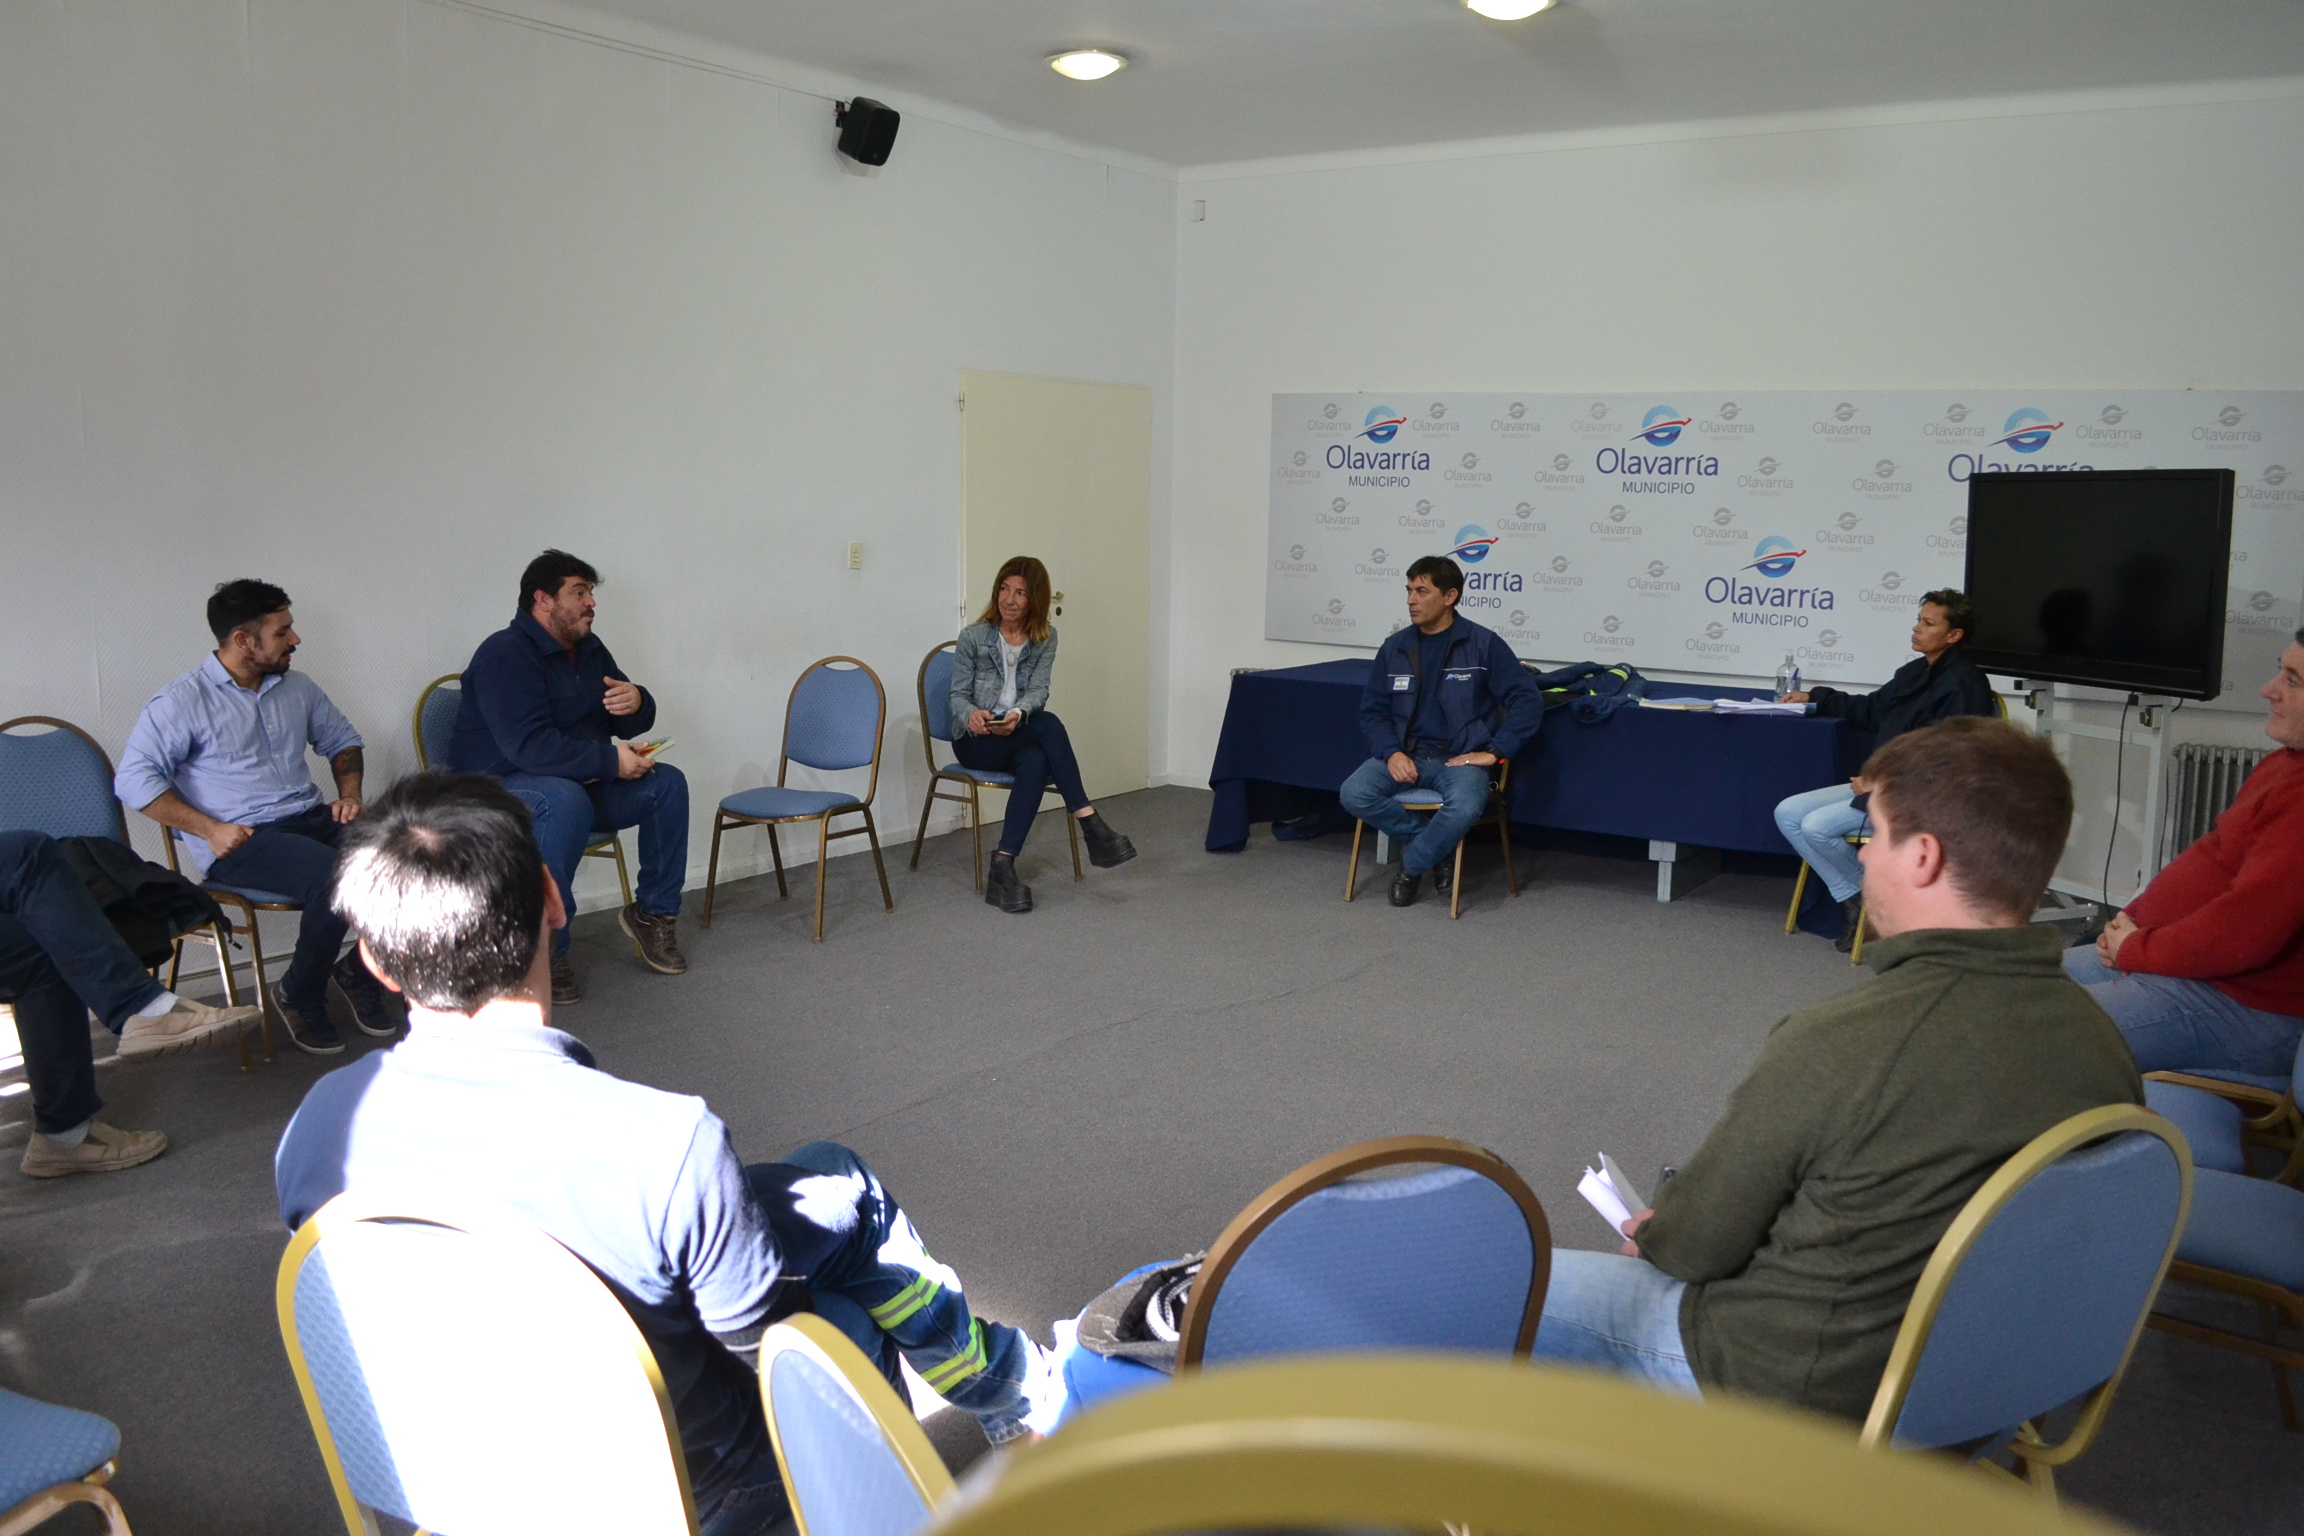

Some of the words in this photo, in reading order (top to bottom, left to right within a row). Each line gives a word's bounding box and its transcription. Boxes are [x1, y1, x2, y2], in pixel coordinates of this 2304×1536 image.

[1326, 444, 1430, 470] Olavarría
[1596, 447, 1719, 477] Olavarría
[1348, 476, 1410, 487] MUNICIPIO
[1622, 481, 1695, 494] MUNICIPIO
[1925, 535, 1964, 548] Olava
[1463, 571, 1523, 593] arría
[1704, 576, 1834, 610] Olavarría
[1460, 596, 1502, 609] NICIPIO
[1732, 612, 1809, 628] MUNICIPIO
